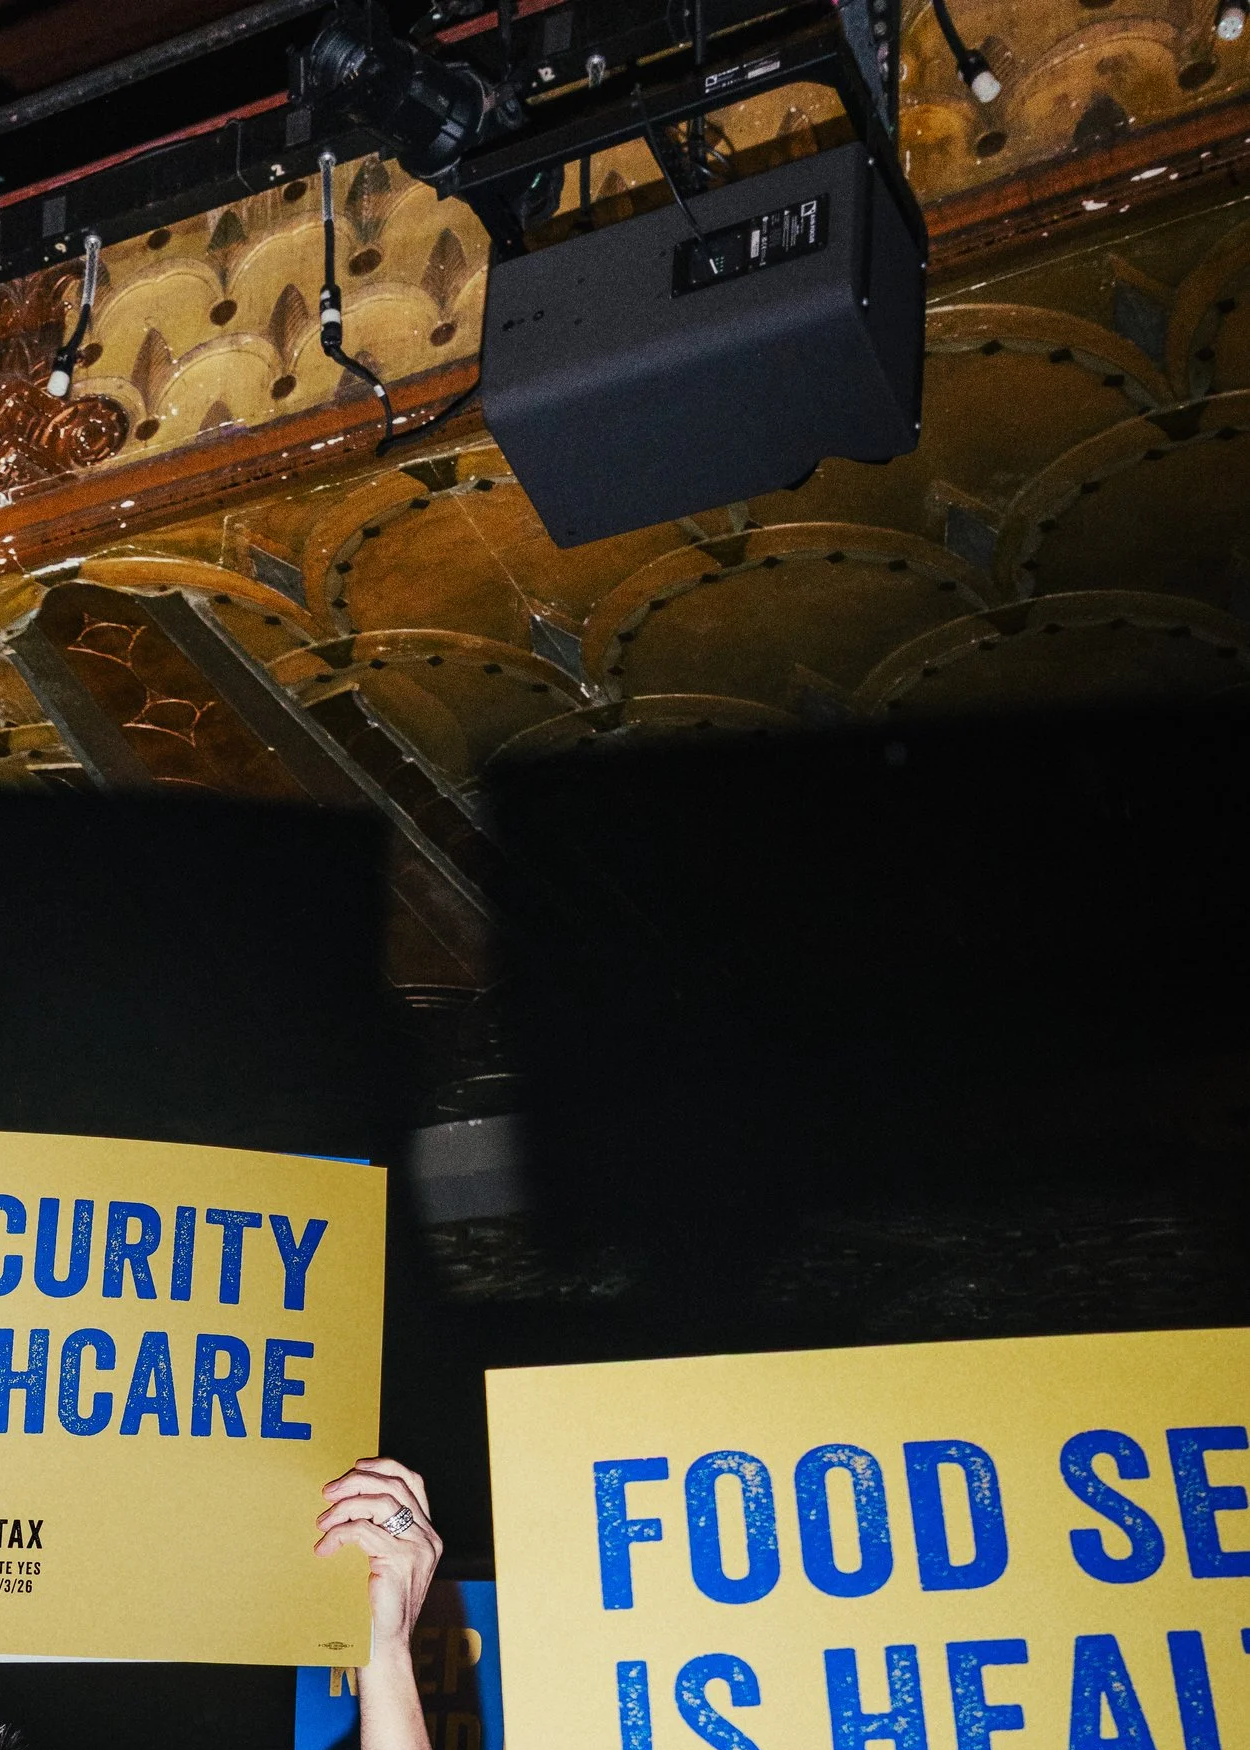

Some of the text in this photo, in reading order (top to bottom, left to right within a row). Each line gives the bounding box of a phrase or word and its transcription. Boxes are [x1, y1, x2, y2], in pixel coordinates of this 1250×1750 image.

[593, 1425, 1250, 1611] FOOD SE
[17, 1561, 42, 1576] YES
